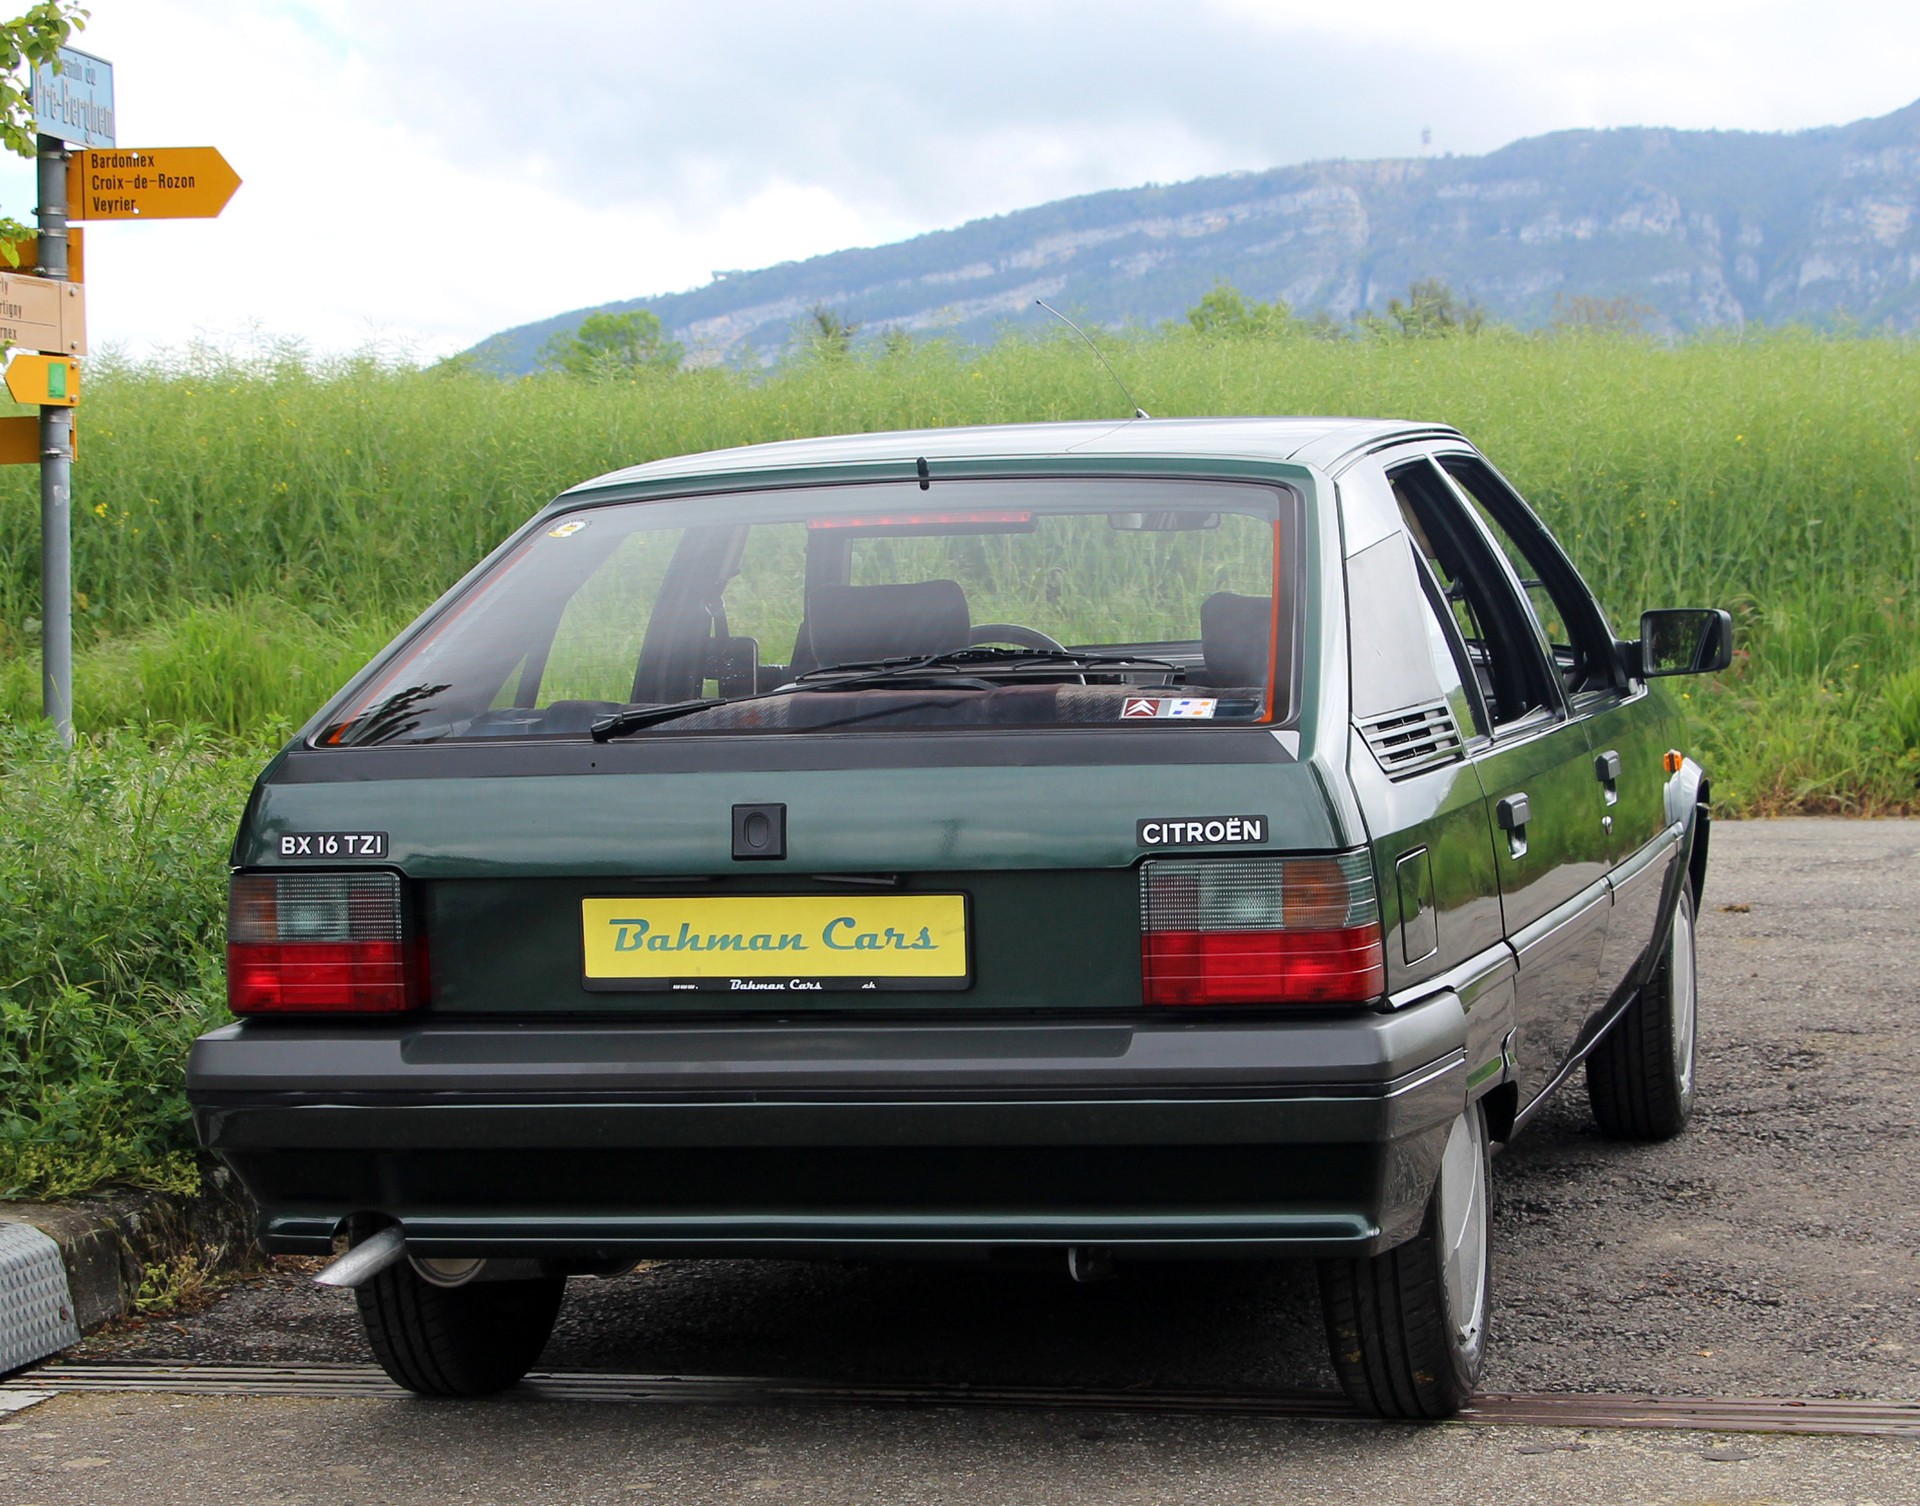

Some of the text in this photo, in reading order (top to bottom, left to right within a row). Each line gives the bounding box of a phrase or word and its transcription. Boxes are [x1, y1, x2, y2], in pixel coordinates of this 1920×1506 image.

[91, 153, 155, 168] Bardonnex
[92, 173, 195, 190] Croix-de-Rozon
[93, 196, 136, 213] Veyrier
[1142, 817, 1261, 844] CITROËN
[281, 835, 381, 855] BX 16 TZI
[608, 917, 939, 952] Bahman Cars
[729, 979, 785, 990] Bahman
[789, 979, 822, 990] Cars
